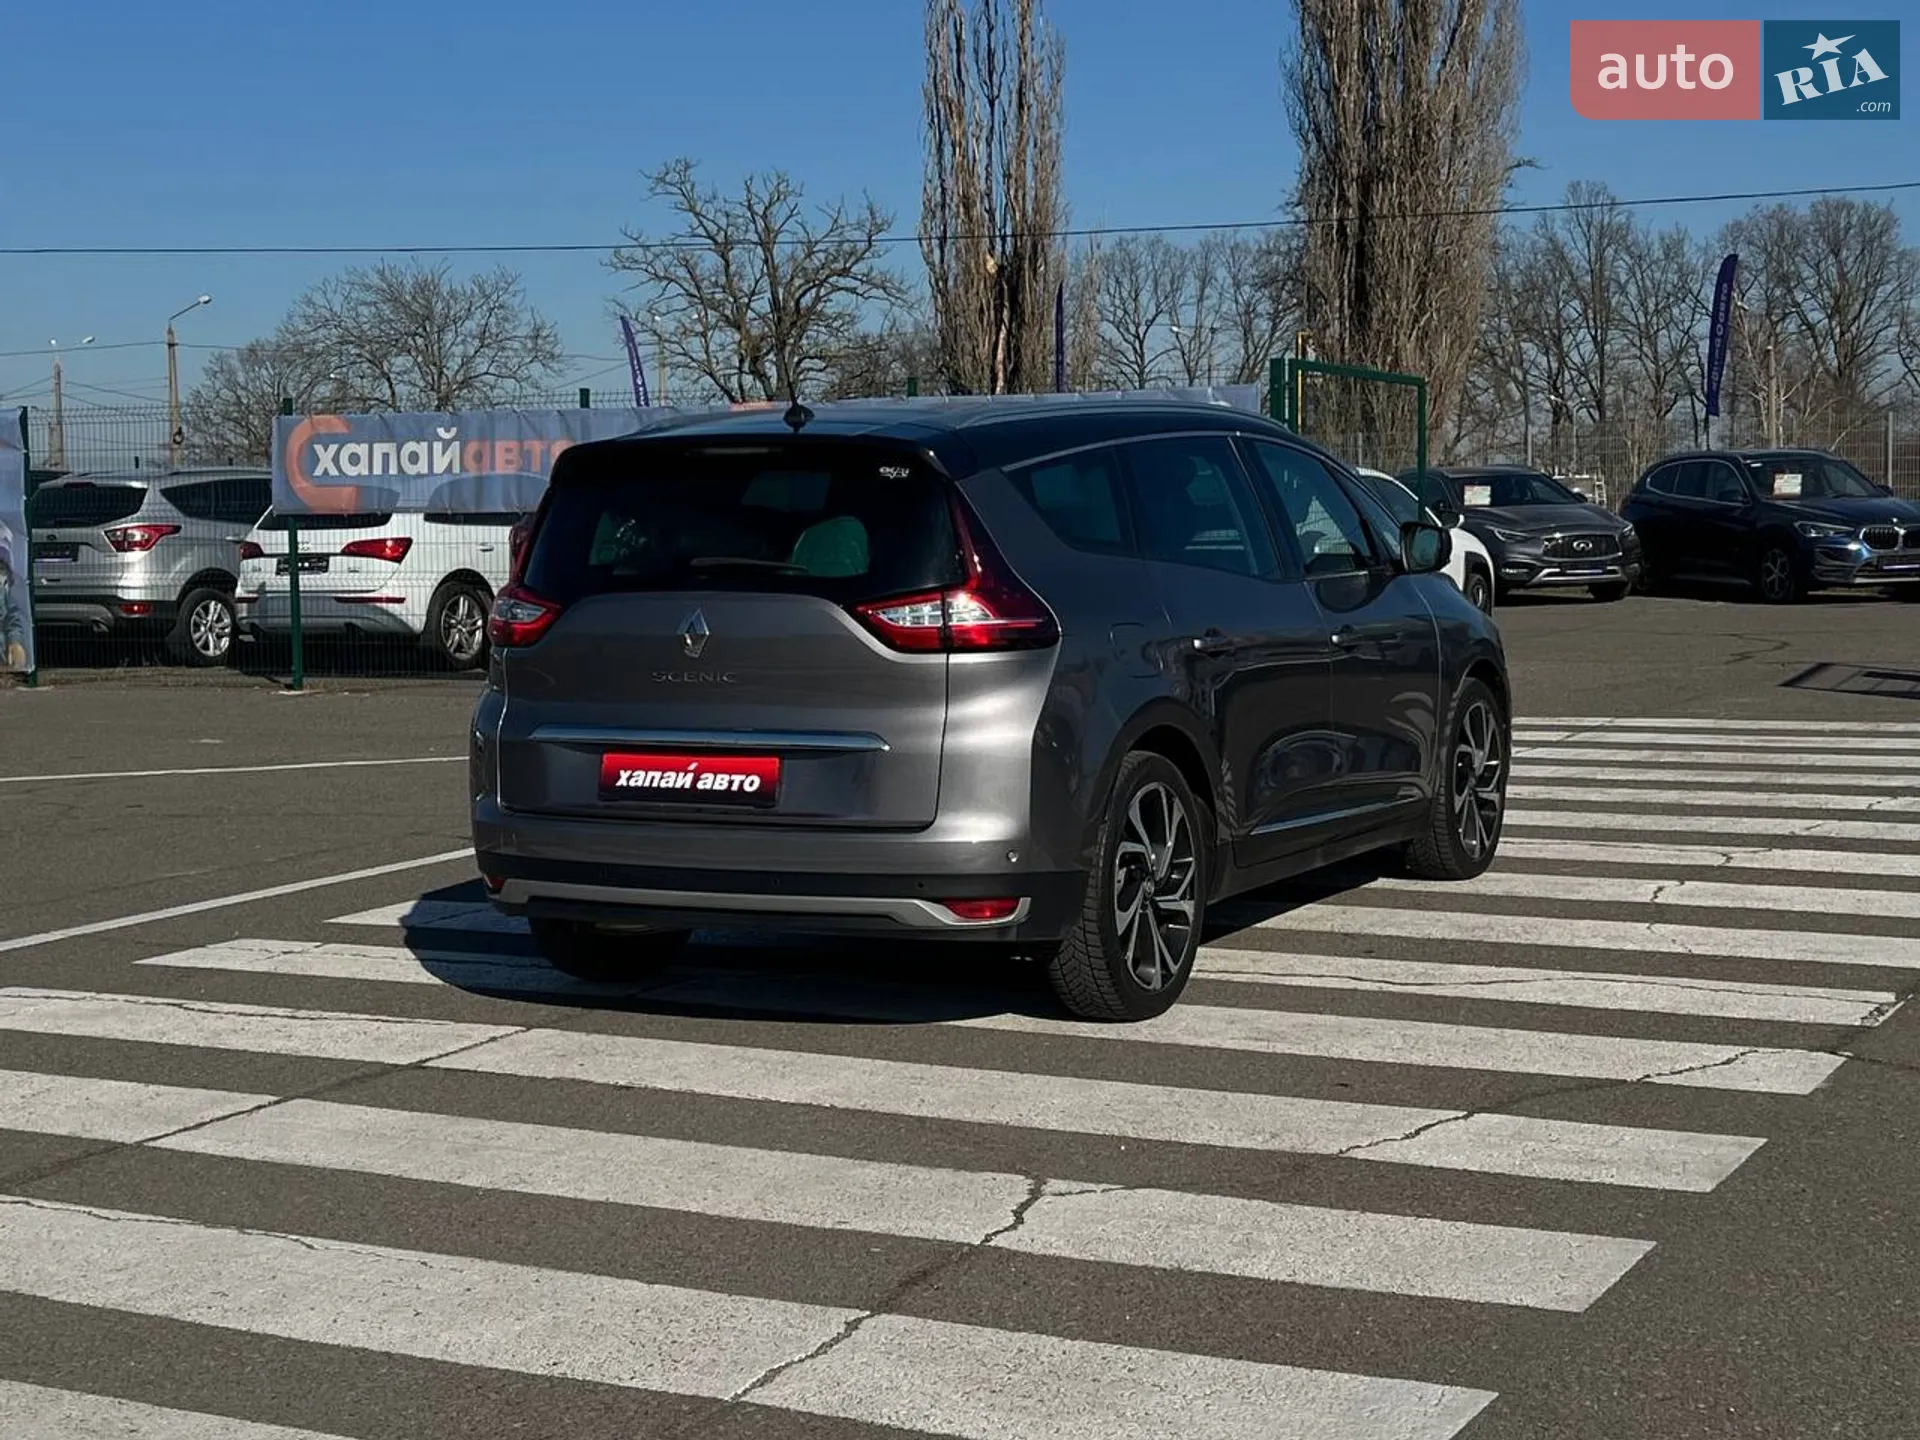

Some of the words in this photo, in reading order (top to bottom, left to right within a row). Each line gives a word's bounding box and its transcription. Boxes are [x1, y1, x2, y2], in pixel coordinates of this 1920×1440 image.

[312, 427, 461, 477] хапай
[651, 671, 738, 684] SCENIC
[696, 772, 761, 792] авто
